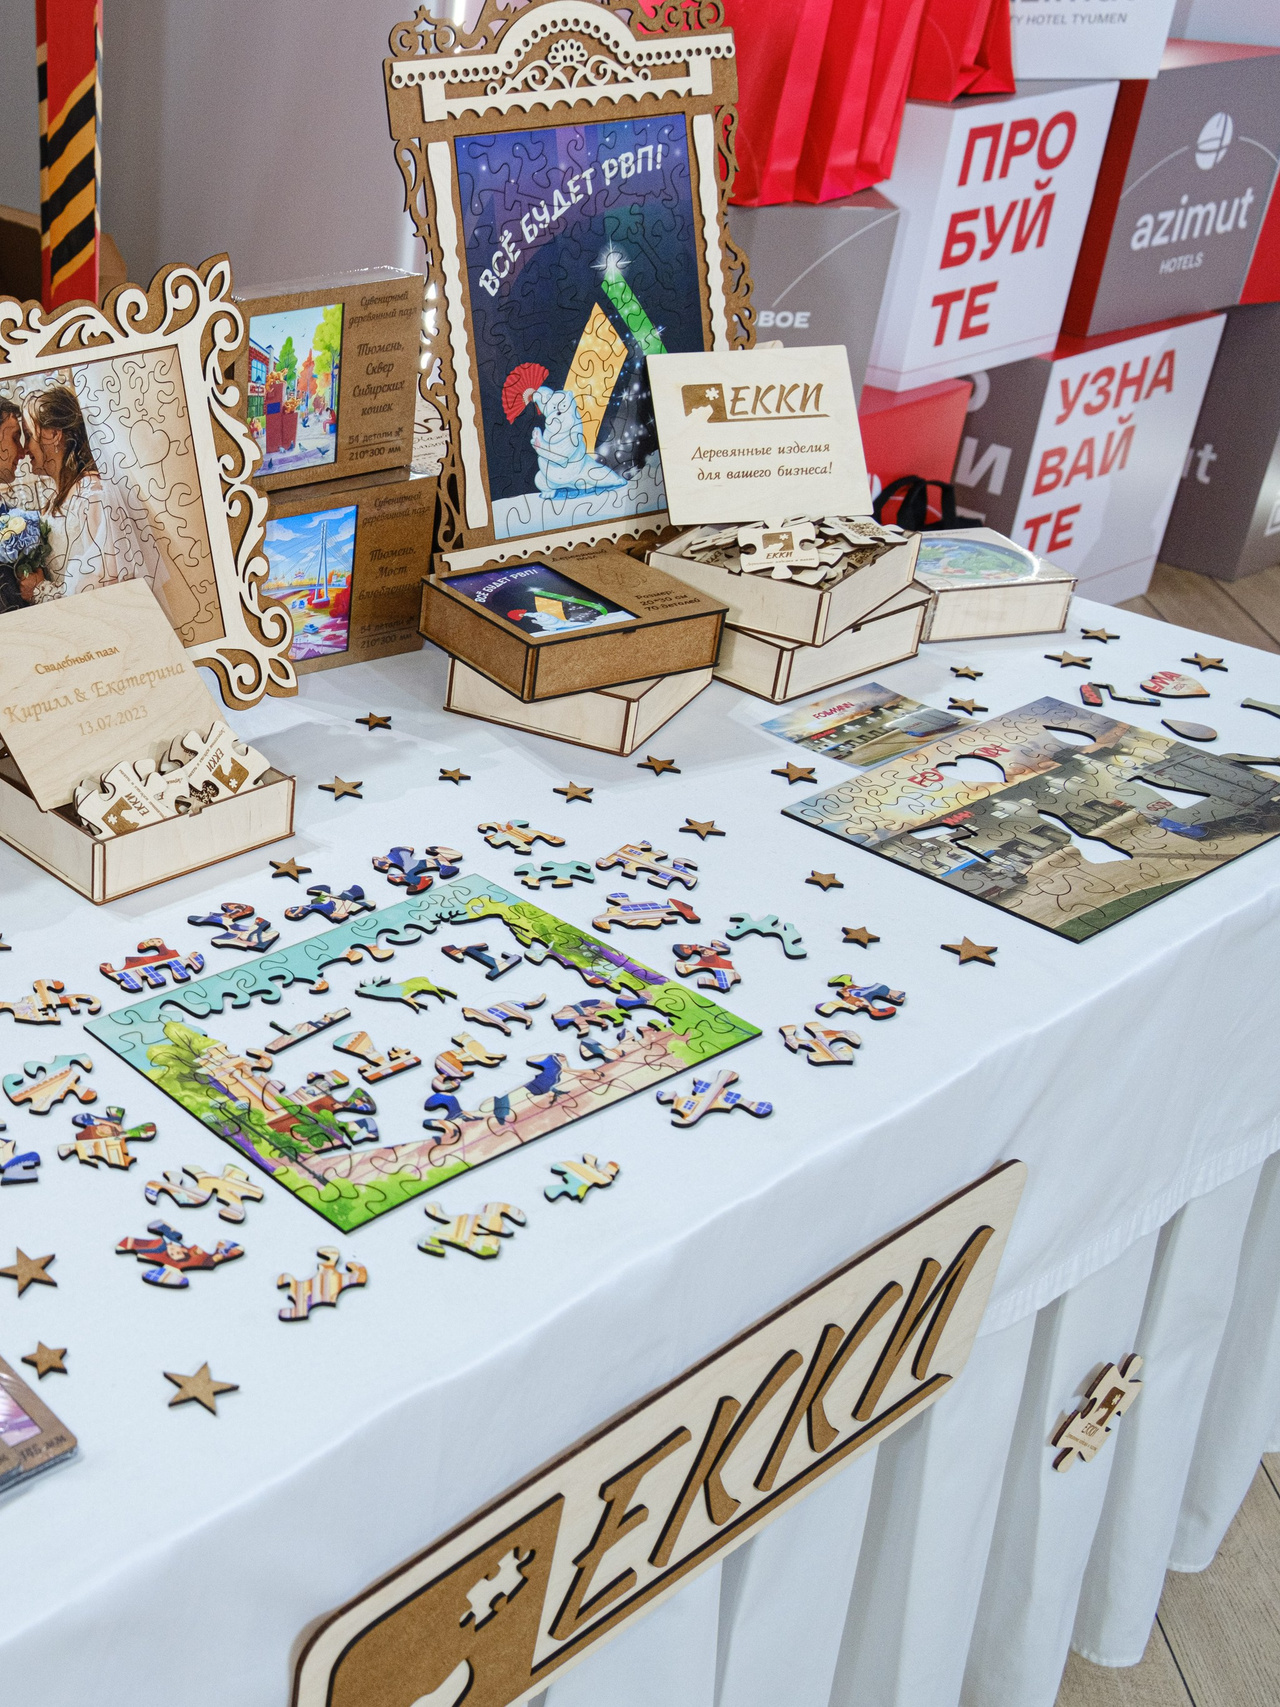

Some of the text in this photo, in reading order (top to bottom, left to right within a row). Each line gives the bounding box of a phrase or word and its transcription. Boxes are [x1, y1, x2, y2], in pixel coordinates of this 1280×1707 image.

[1026, 13, 1067, 26] HOTEL
[1072, 12, 1128, 25] TYUMEN
[957, 110, 1077, 188] ПРО
[478, 143, 663, 297] ВСЁ БУДЕТ РВП!
[939, 176, 1056, 271] БУЙ
[1130, 187, 1255, 252] azimut
[1158, 251, 1204, 275] HOTELS
[360, 290, 408, 310] Сувенирный
[349, 309, 397, 328] деревянный
[754, 310, 811, 329] ВОЕ
[930, 280, 999, 347] ТЕ
[366, 361, 394, 377] Сквер
[352, 379, 406, 399] Сибирских
[729, 382, 824, 416] ЕККИ
[1054, 348, 1176, 426] УЗНА
[361, 402, 393, 417] кошек
[348, 433, 360, 444] 54
[691, 441, 831, 462] Деревянные изделия
[1031, 412, 1137, 497] ВАЙ
[697, 462, 833, 481] для вашего бизнеса!
[1023, 503, 1083, 554] ТЕ
[765, 550, 794, 559] ЕККИ
[487, 576, 511, 594] БУДЕТ
[34, 643, 121, 676] Свадебный пазл
[3, 659, 187, 725] Кирилл & Екатерина
[78, 704, 150, 738] 13.07.2023
[206, 747, 226, 772] ЕККИ
[124, 792, 150, 817] ЕККИ
[547, 1224, 996, 1641] ЕККИ
